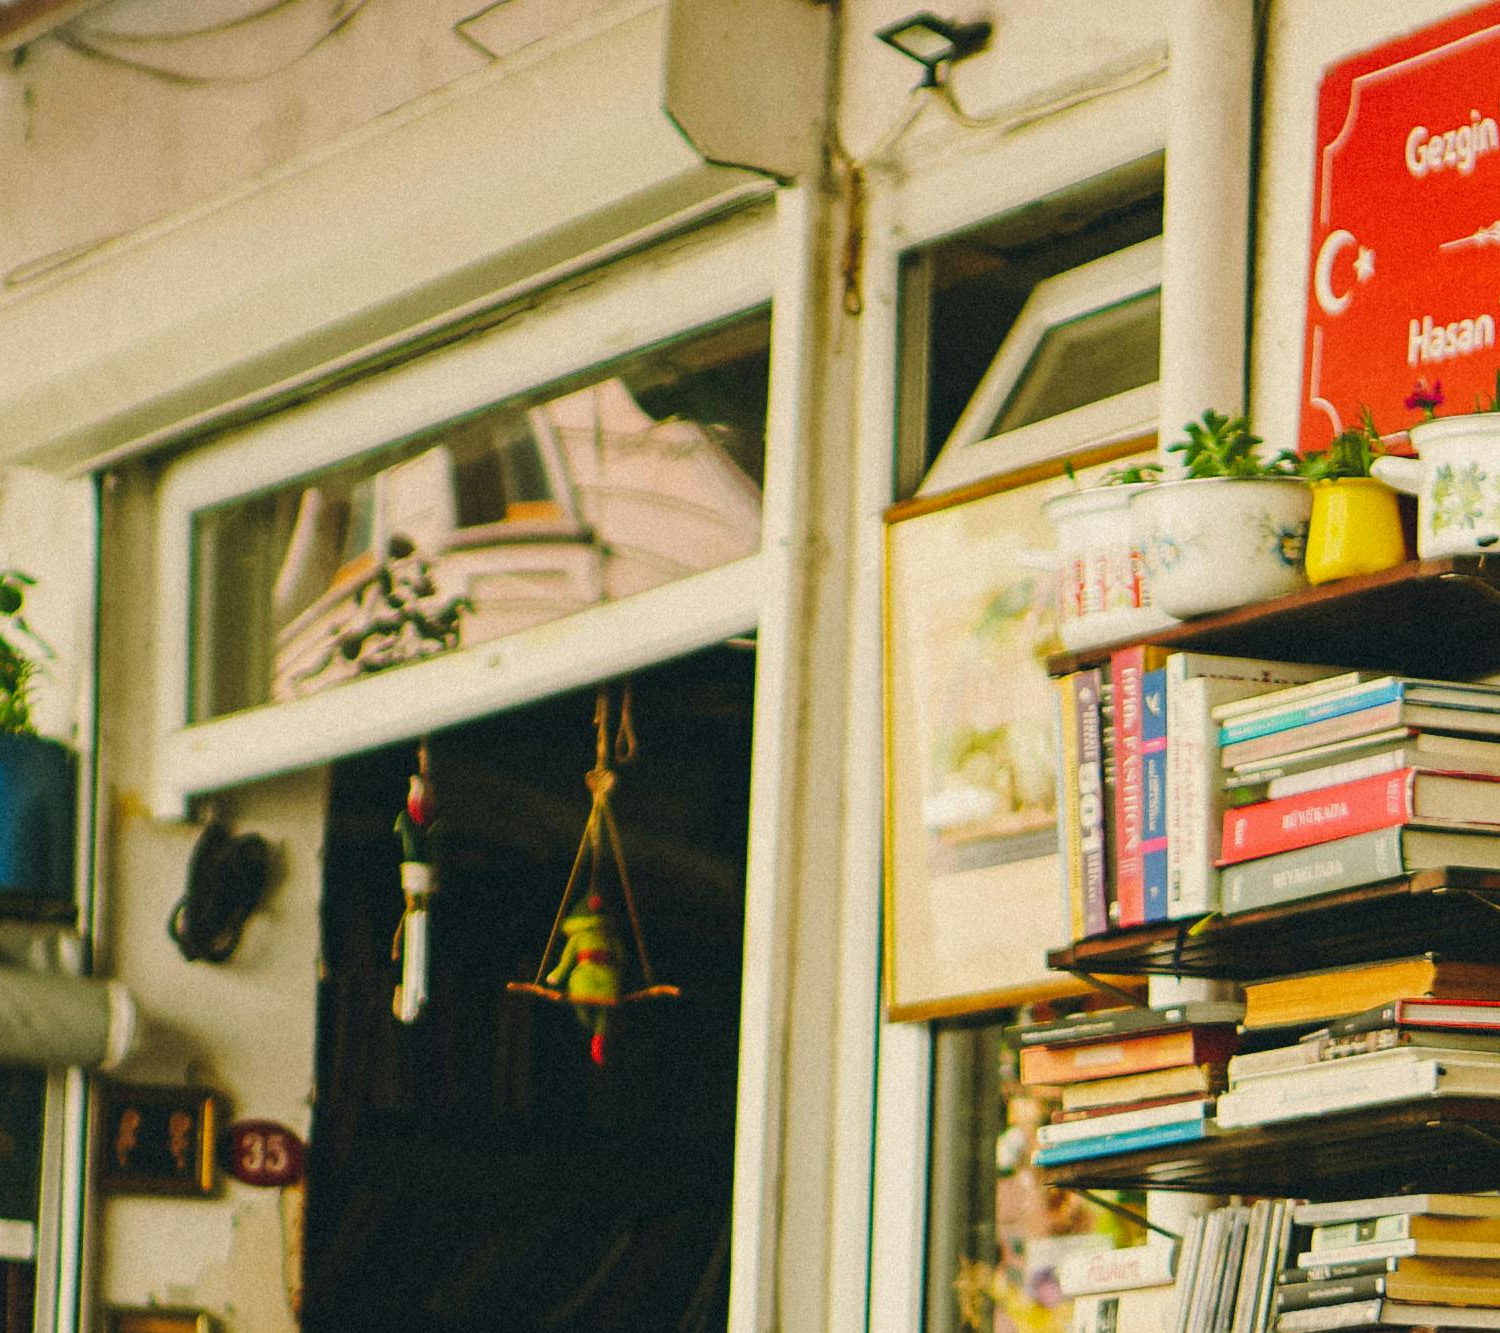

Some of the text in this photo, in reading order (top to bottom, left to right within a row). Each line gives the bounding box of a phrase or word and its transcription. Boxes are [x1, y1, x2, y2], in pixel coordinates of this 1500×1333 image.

[1406, 110, 1499, 178] Gezgin
[1407, 312, 1496, 367] Hasan
[241, 1132, 289, 1174] 35
